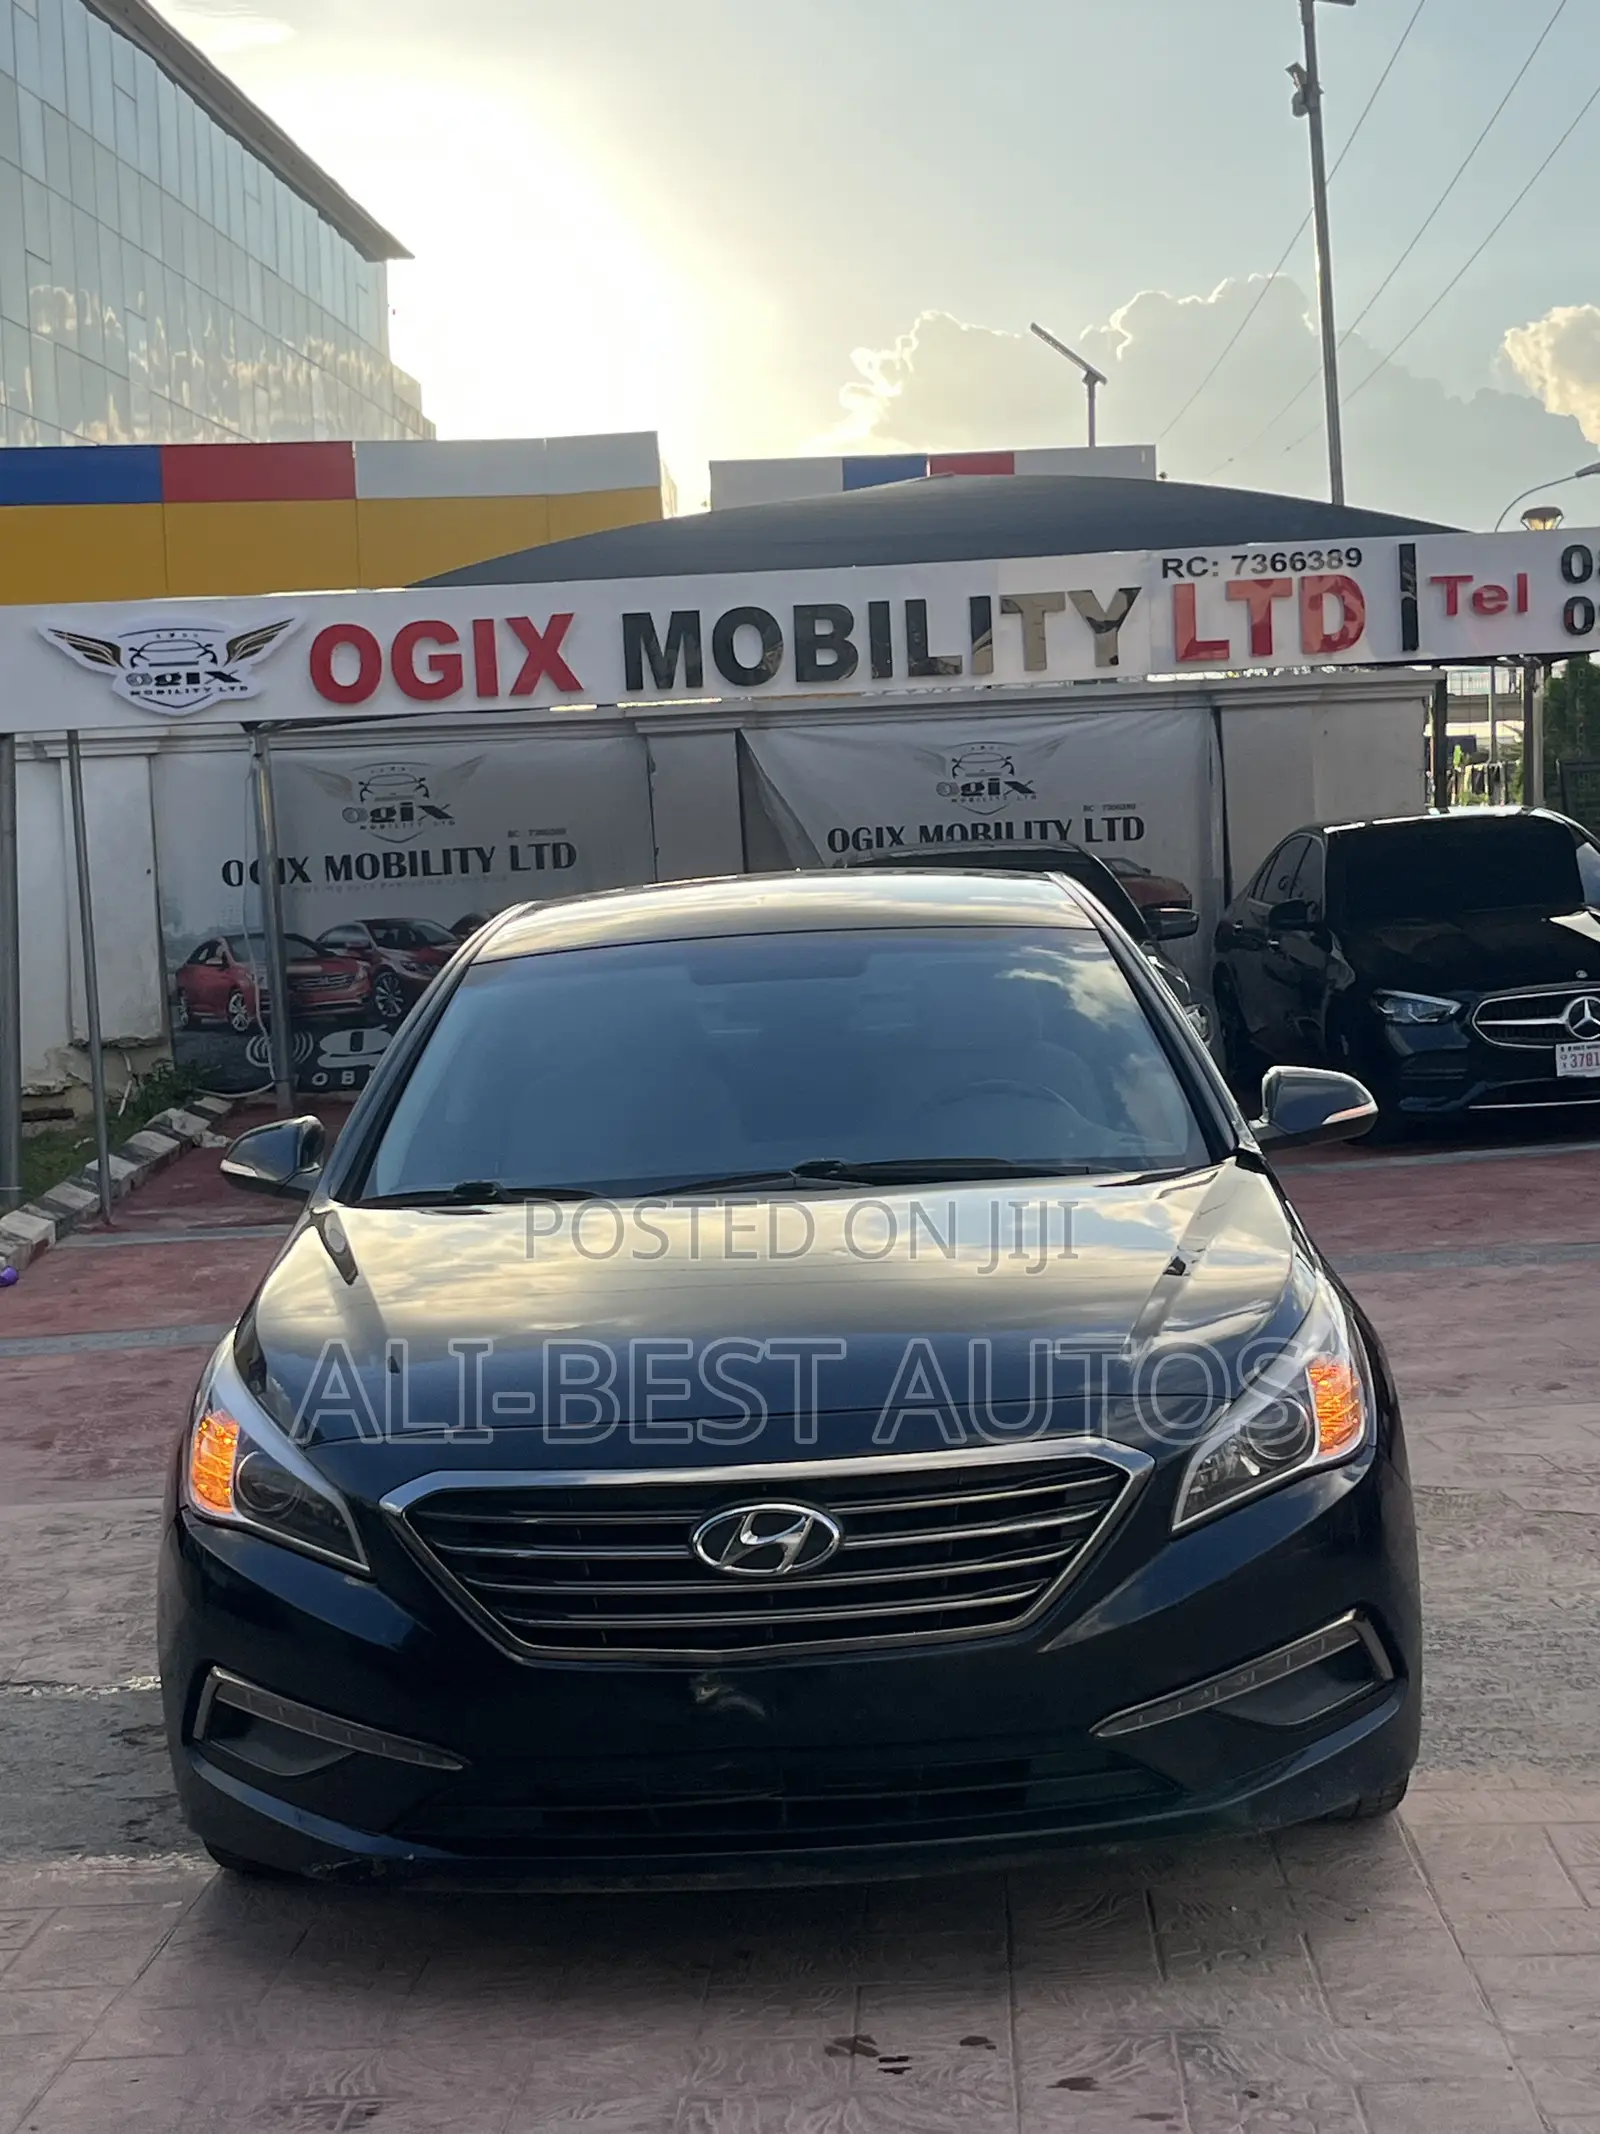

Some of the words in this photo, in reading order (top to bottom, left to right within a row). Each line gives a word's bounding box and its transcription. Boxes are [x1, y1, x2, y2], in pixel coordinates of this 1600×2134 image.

[1161, 556, 1219, 579] RC:
[1230, 547, 1363, 575] 7366389
[1560, 544, 1600, 584] 0
[1429, 572, 1529, 617] Tel
[1562, 595, 1600, 636] 0
[309, 612, 584, 704] OGIX
[622, 587, 1142, 692] MOBILITY
[1172, 574, 1366, 663] LTD
[827, 826, 904, 853] OGIX
[1084, 816, 1145, 843] LTD
[325, 846, 496, 882] MOBILITY
[509, 841, 577, 872] LTD
